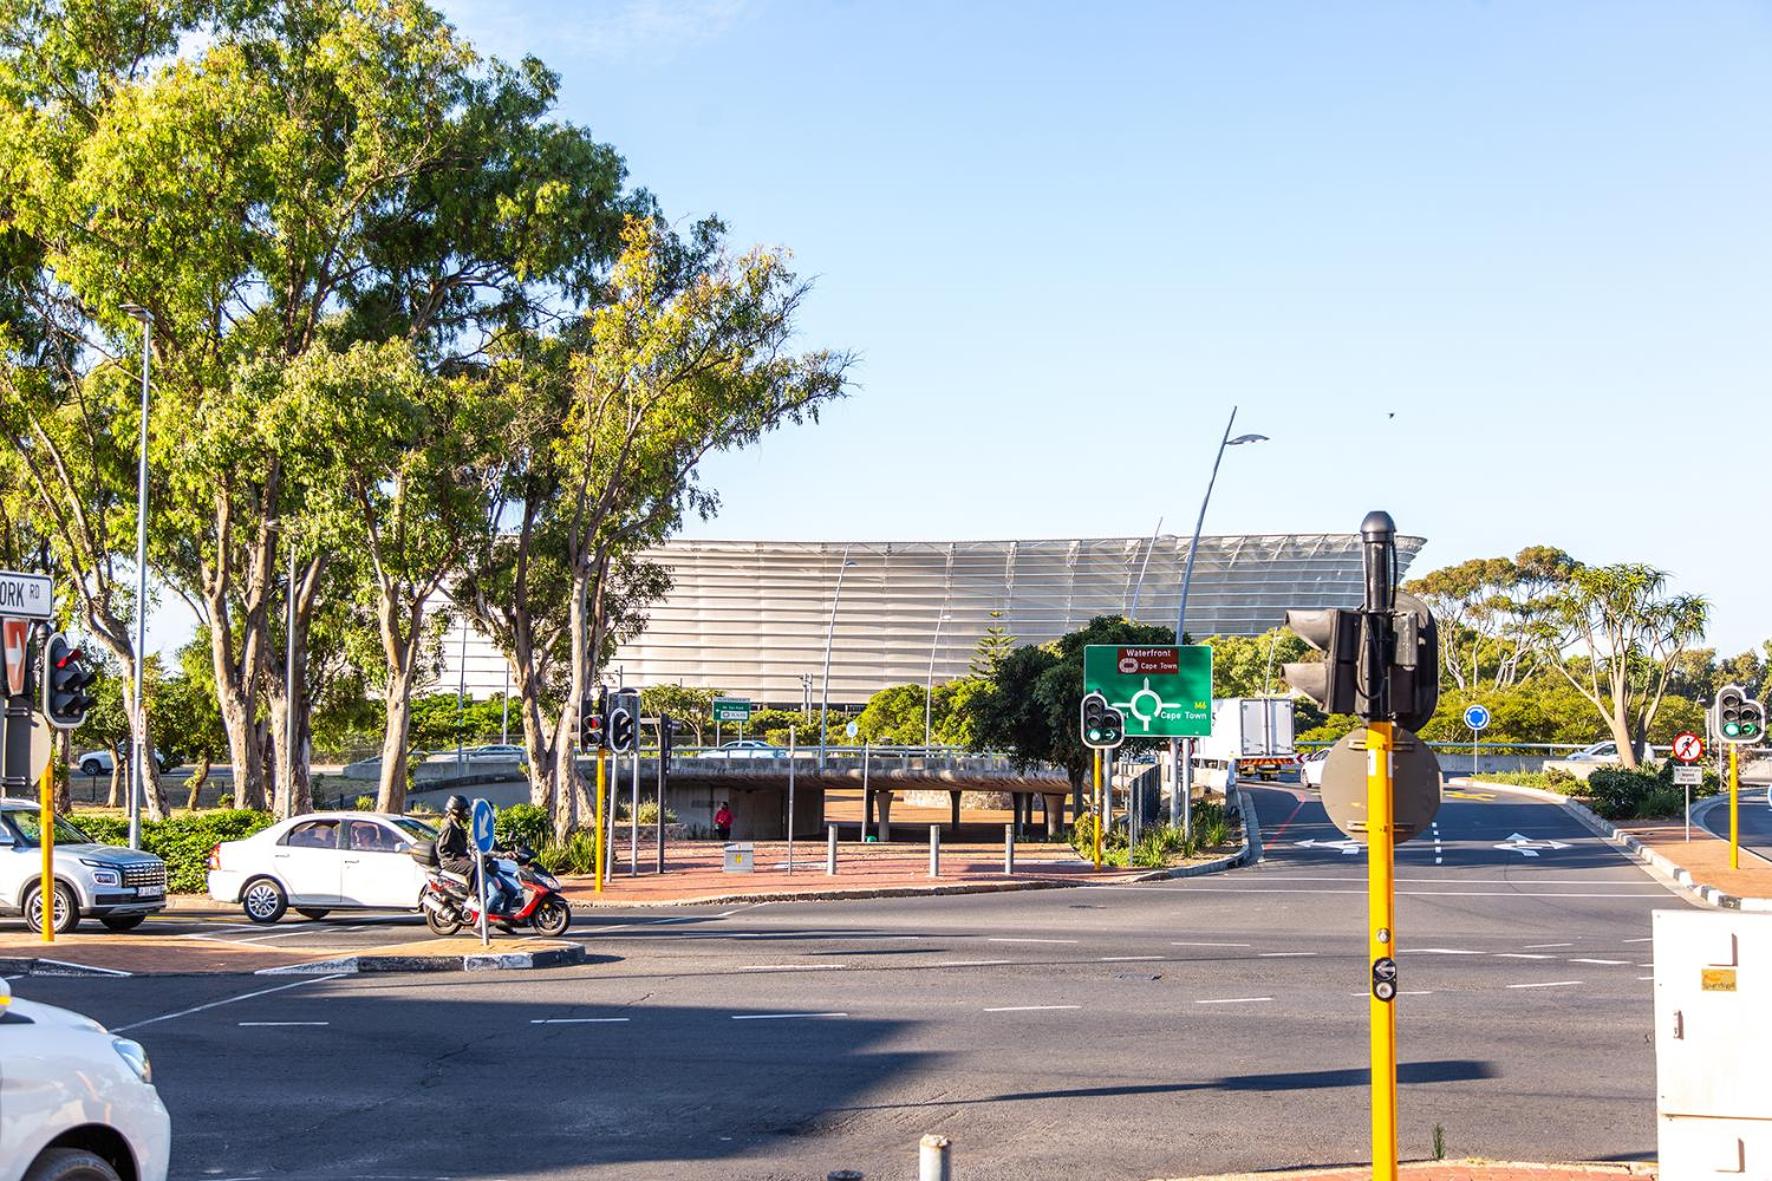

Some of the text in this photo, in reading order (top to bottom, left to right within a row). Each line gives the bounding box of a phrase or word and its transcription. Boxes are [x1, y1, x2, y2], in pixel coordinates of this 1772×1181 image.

[29, 584, 40, 599] RD
[1126, 649, 1171, 657] Waterfront
[1160, 711, 1206, 720] Cape Town
